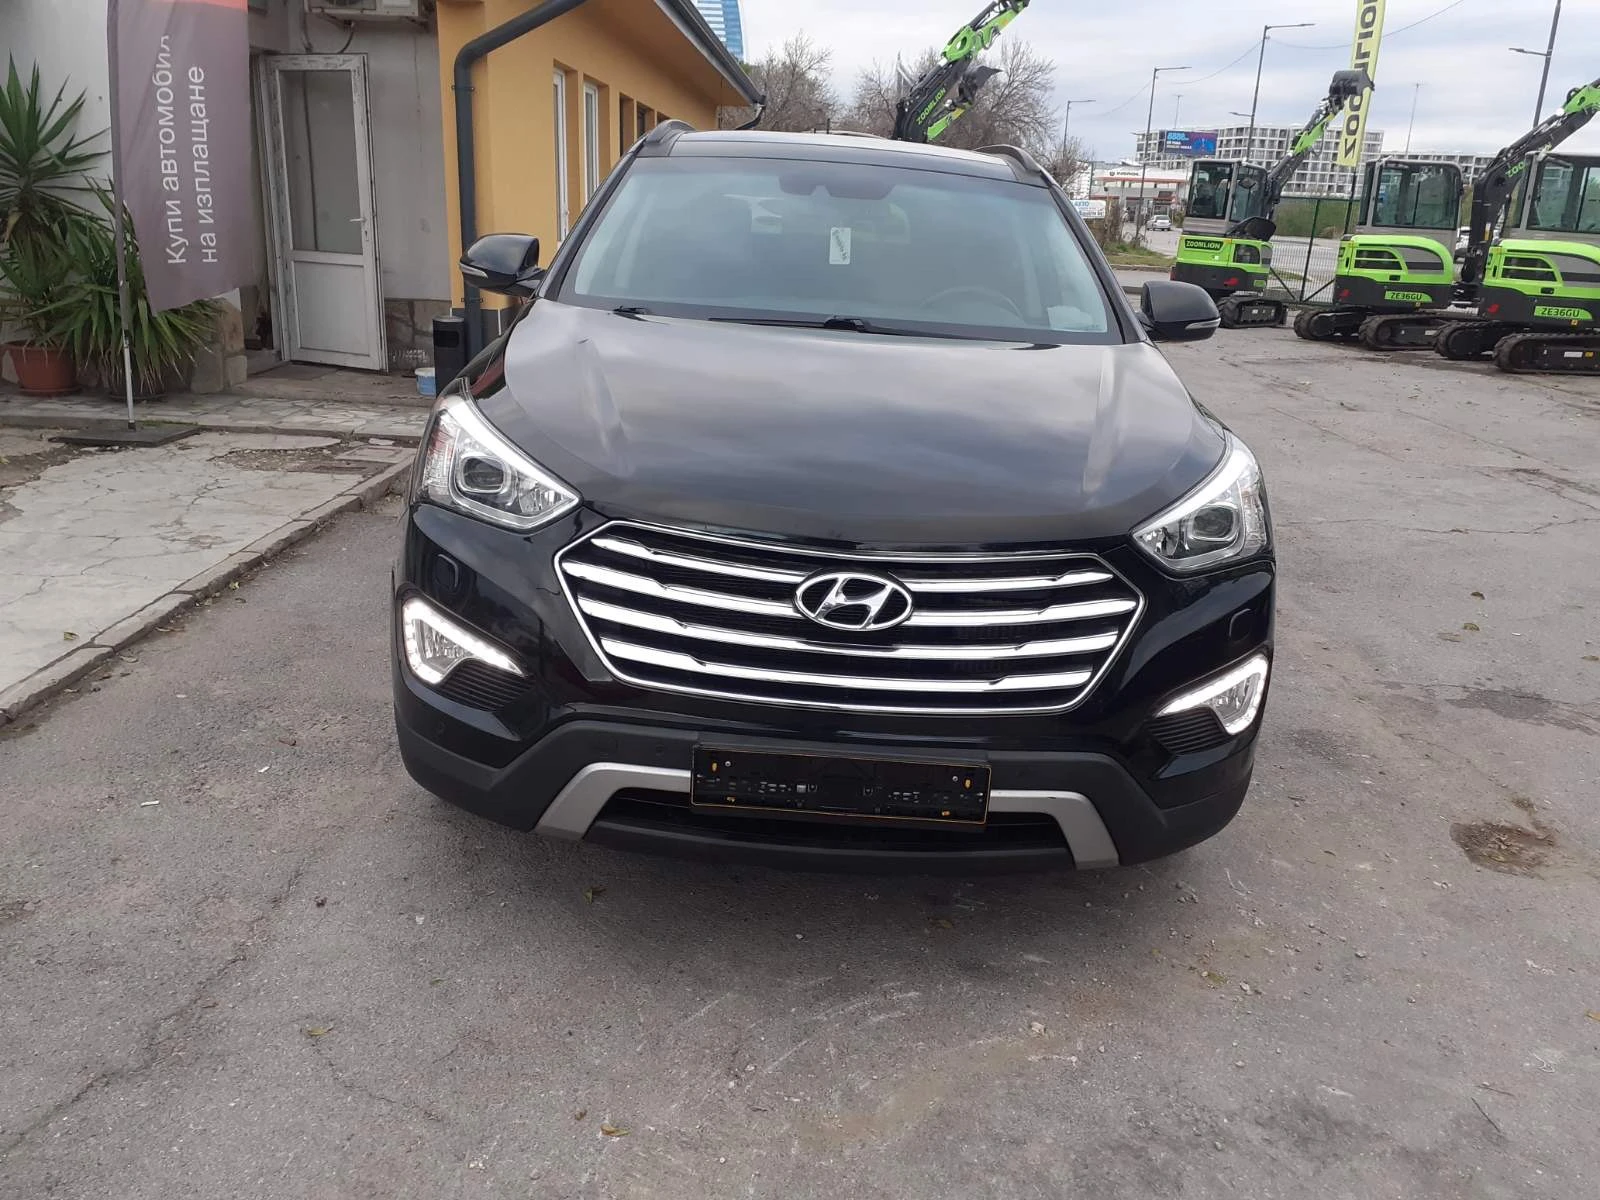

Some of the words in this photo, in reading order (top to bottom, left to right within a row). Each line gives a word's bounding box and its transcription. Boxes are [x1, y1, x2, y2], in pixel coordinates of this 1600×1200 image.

[152, 34, 180, 191] автомобил
[188, 66, 214, 223] изплащане
[165, 200, 189, 264] Купи
[201, 232, 218, 263] на
[1186, 240, 1221, 249] ZOOMLION
[1390, 292, 1422, 301] ZE36GU
[1541, 307, 1580, 318] ZE36GU
